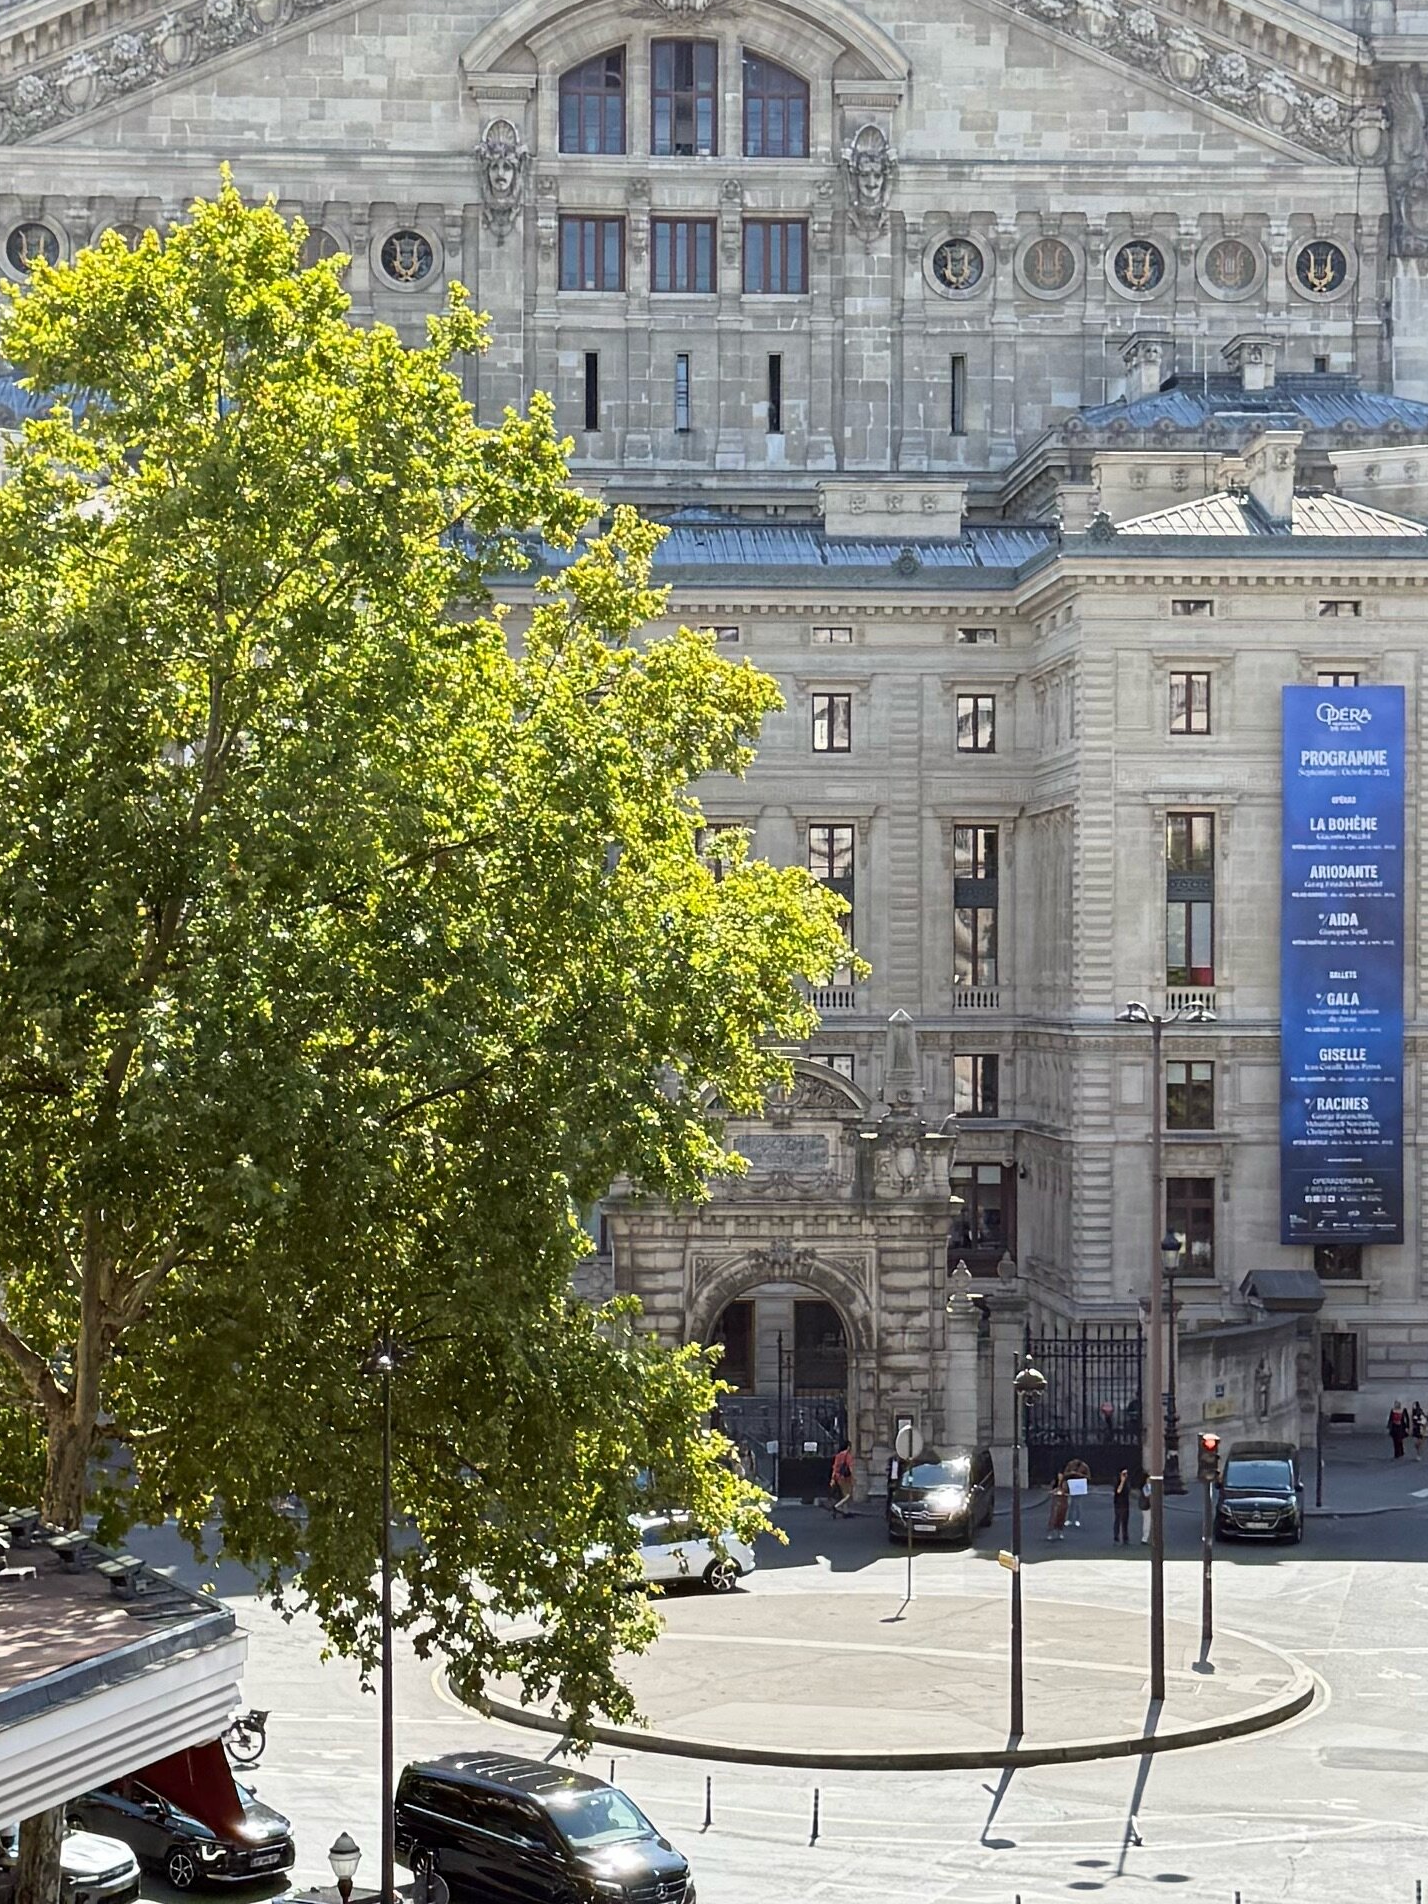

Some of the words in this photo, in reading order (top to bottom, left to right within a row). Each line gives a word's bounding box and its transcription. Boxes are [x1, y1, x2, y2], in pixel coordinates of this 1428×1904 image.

[1300, 750, 1388, 766] PROGRAMME
[1310, 817, 1326, 831] LA
[1328, 814, 1378, 831] BOHÈME
[1310, 865, 1378, 879] ARIODANTE
[1328, 913, 1359, 926] AIDA
[1326, 992, 1360, 1006] GALA
[1319, 1048, 1366, 1062] GISELLE
[1317, 1097, 1369, 1110] RACINES
